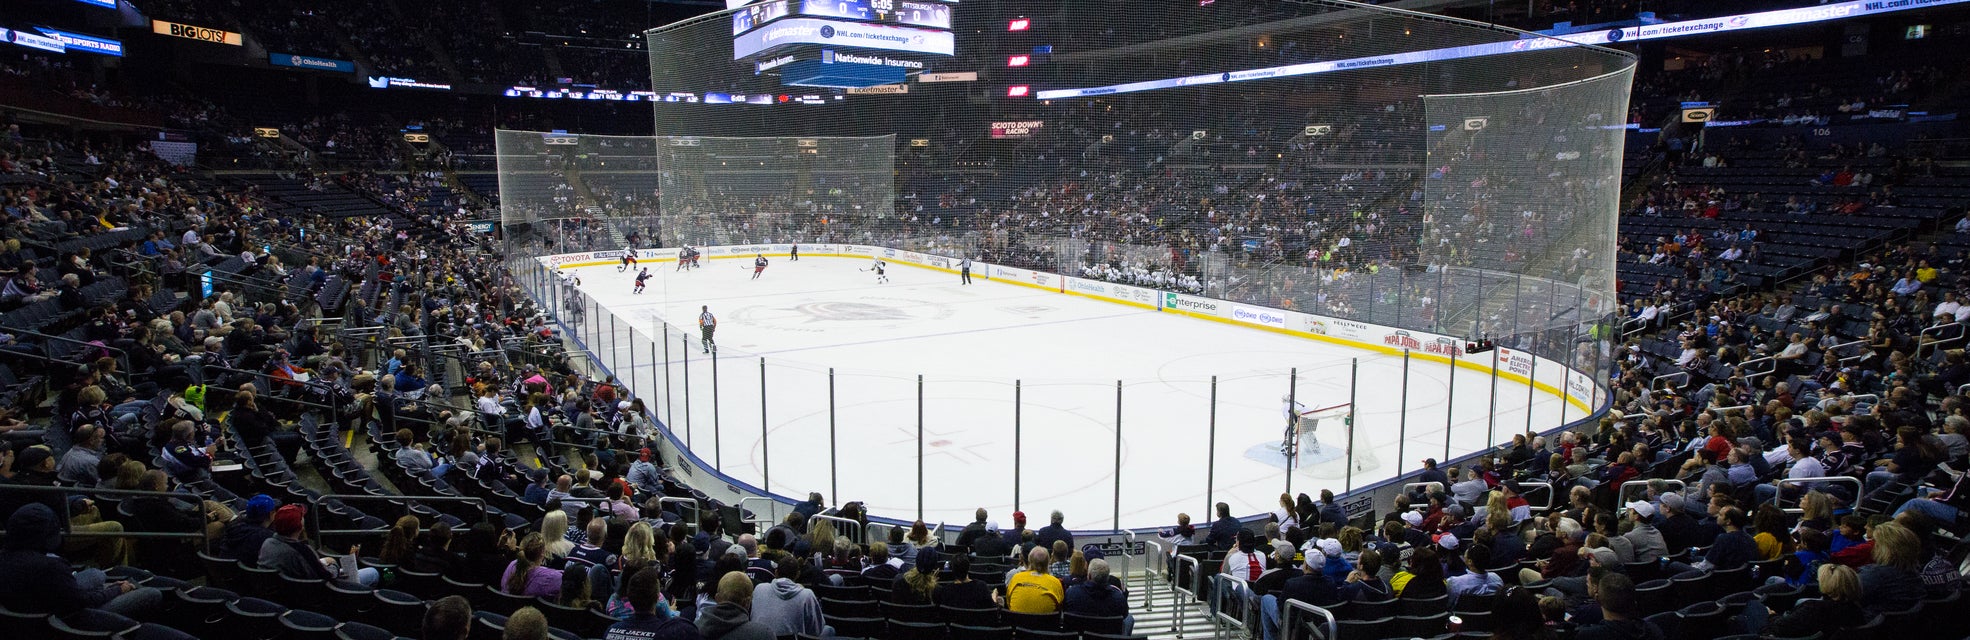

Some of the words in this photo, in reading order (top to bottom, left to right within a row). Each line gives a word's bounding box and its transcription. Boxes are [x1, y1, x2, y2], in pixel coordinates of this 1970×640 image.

[871, 0, 893, 10] 6:05
[902, 2, 931, 11] PITTSBURGH
[913, 11, 920, 21] 0
[170, 23, 195, 38] BIG
[196, 26, 227, 44] LOTS!
[836, 30, 909, 44] NHL.com/ticketexchange
[73, 38, 99, 49] SPORTS
[303, 59, 337, 68] OhioHealth
[834, 53, 883, 66] Nationwide
[885, 57, 923, 69] Insurance
[1813, 128, 1831, 136] 106
[561, 254, 591, 263] TOYOTA
[1170, 297, 1217, 311] enterprise
[1384, 334, 1399, 345] PAPA
[1424, 341, 1441, 354] PAPA
[1508, 366, 1529, 376] POWER
[1346, 498, 1371, 512] LEXUS
